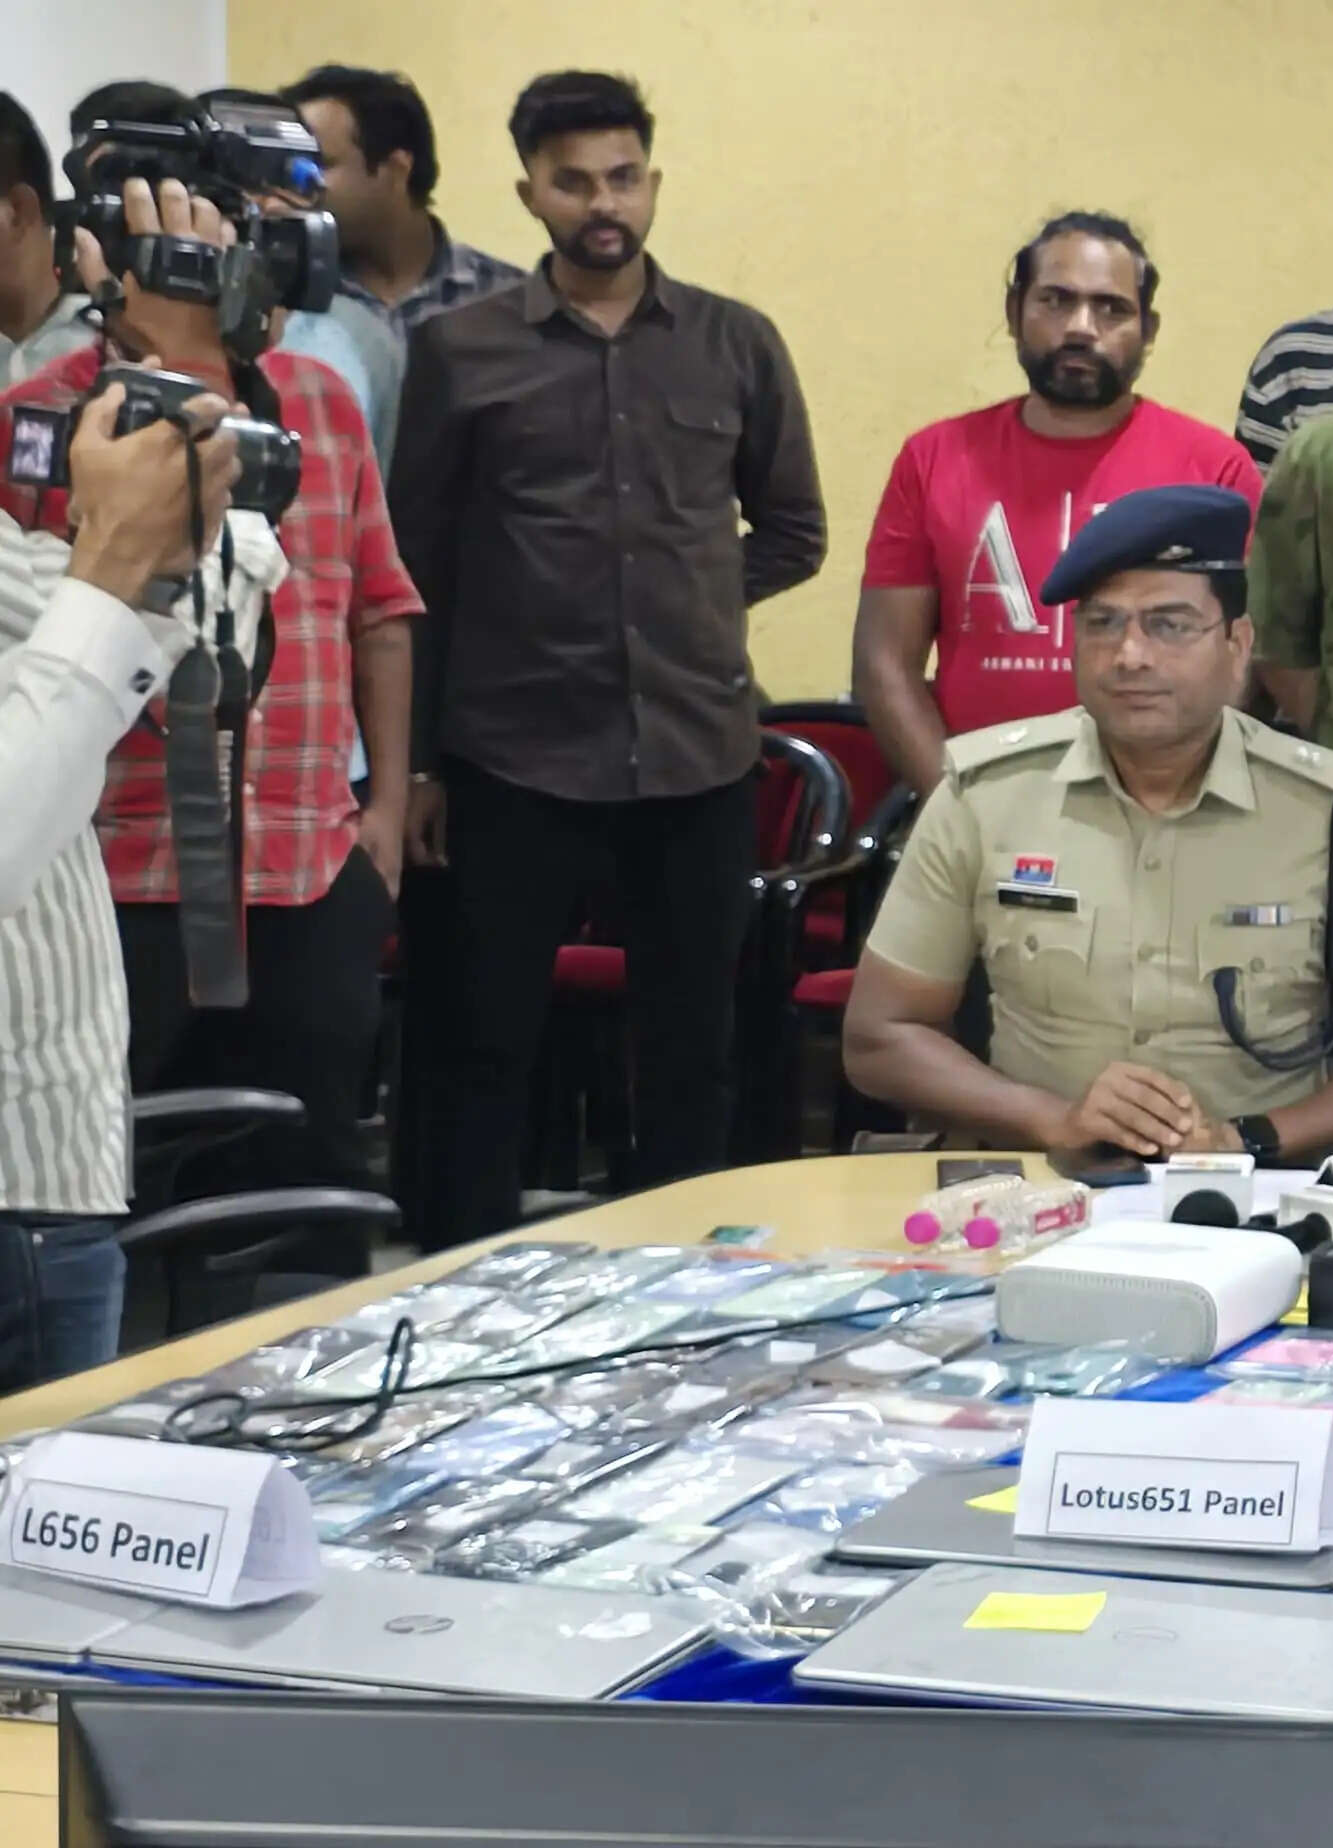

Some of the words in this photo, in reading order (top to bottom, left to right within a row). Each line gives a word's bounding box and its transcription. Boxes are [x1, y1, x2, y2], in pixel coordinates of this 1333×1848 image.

[1060, 1483, 1192, 1514] Lotus651
[1203, 1489, 1286, 1518] Panel
[21, 1507, 101, 1555] L656
[111, 1522, 210, 1572] Panel
